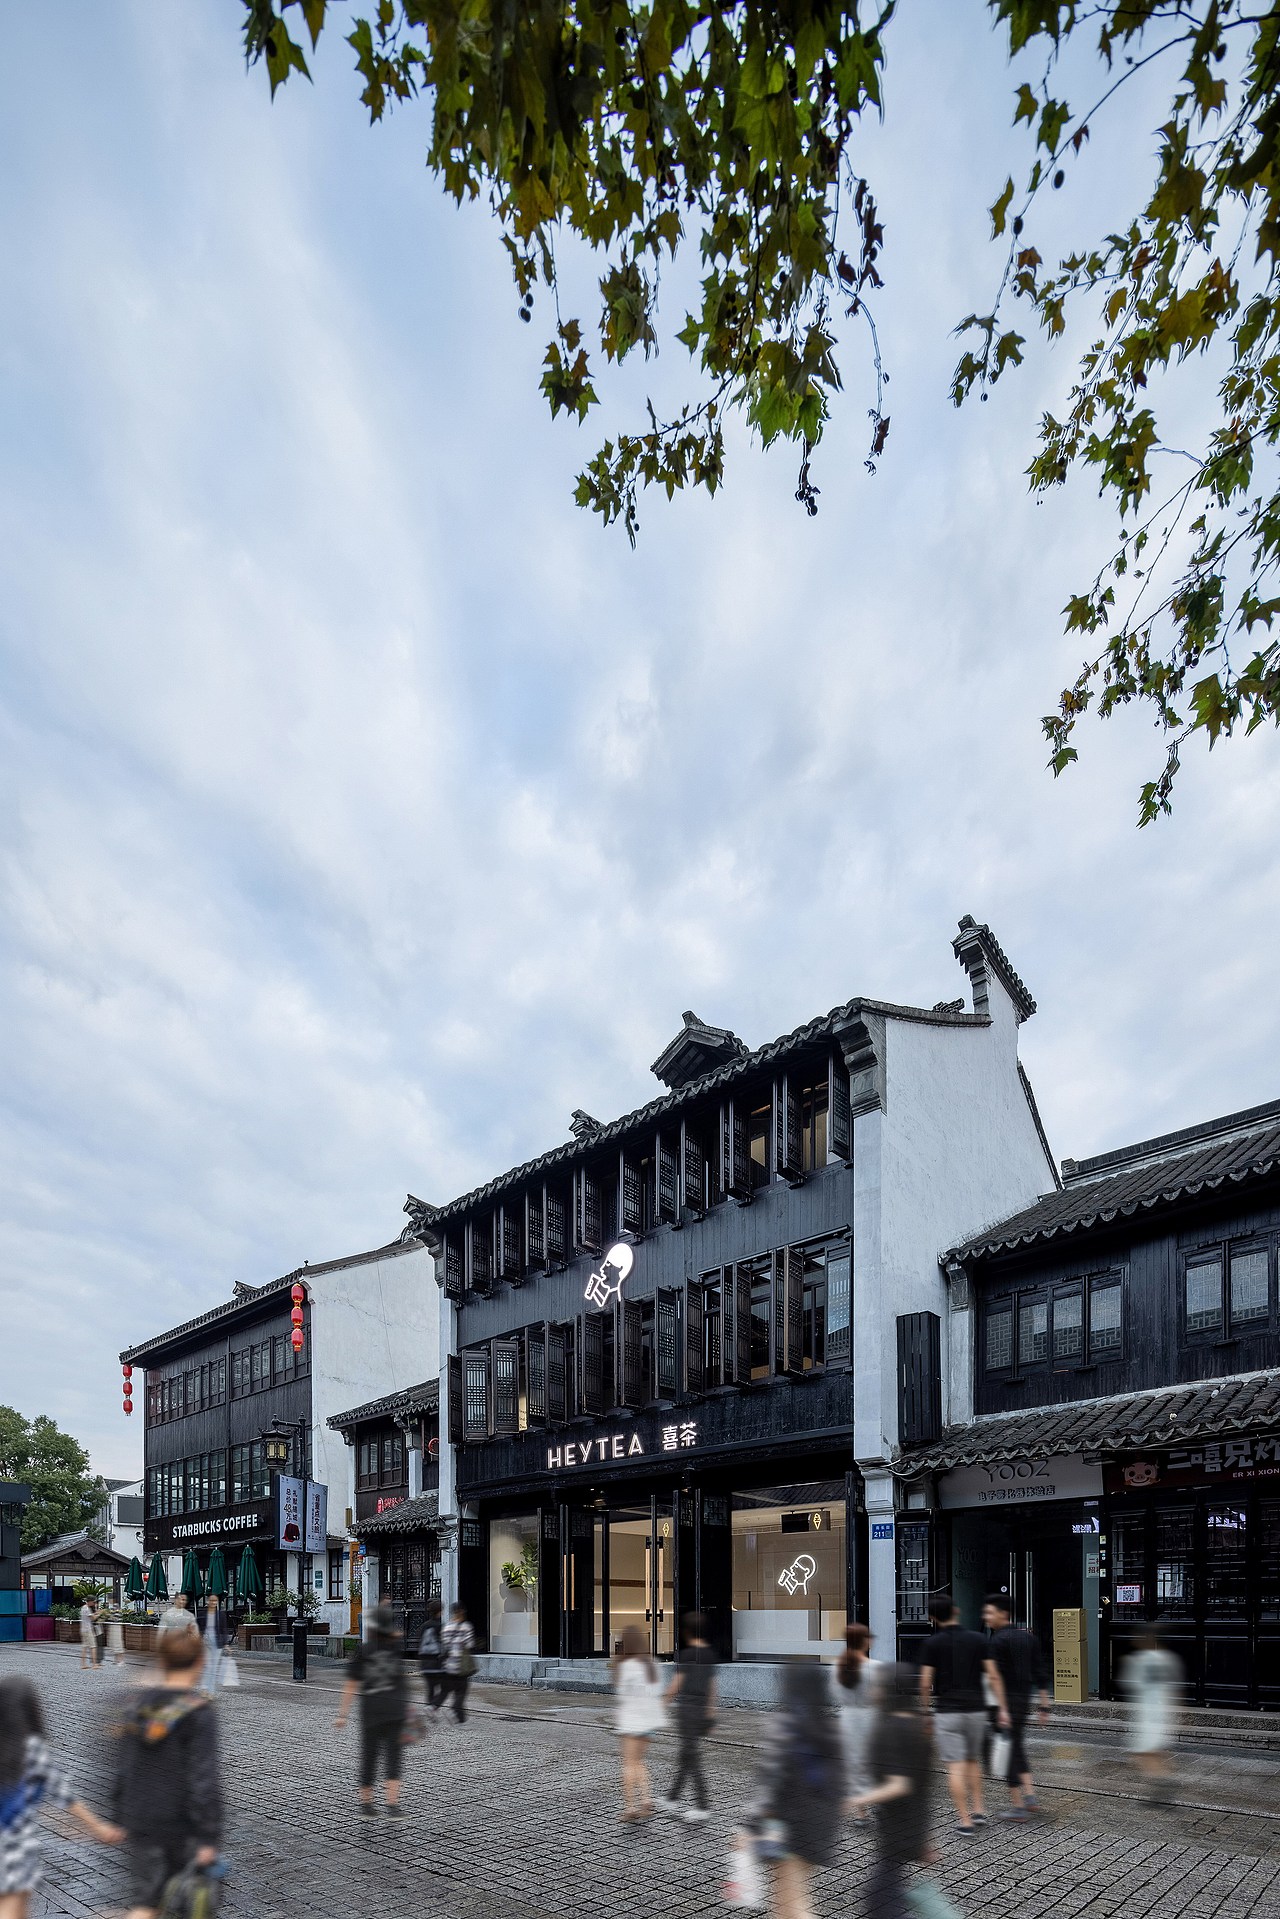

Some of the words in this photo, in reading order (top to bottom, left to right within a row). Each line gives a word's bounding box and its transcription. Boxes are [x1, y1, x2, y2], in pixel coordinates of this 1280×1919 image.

[547, 1431, 644, 1469] HEYTEA
[661, 1421, 698, 1451] 喜茶
[980, 1459, 1050, 1482] YOOZ
[172, 1519, 221, 1538] STARBUCKS
[222, 1513, 258, 1531] COFFEE
